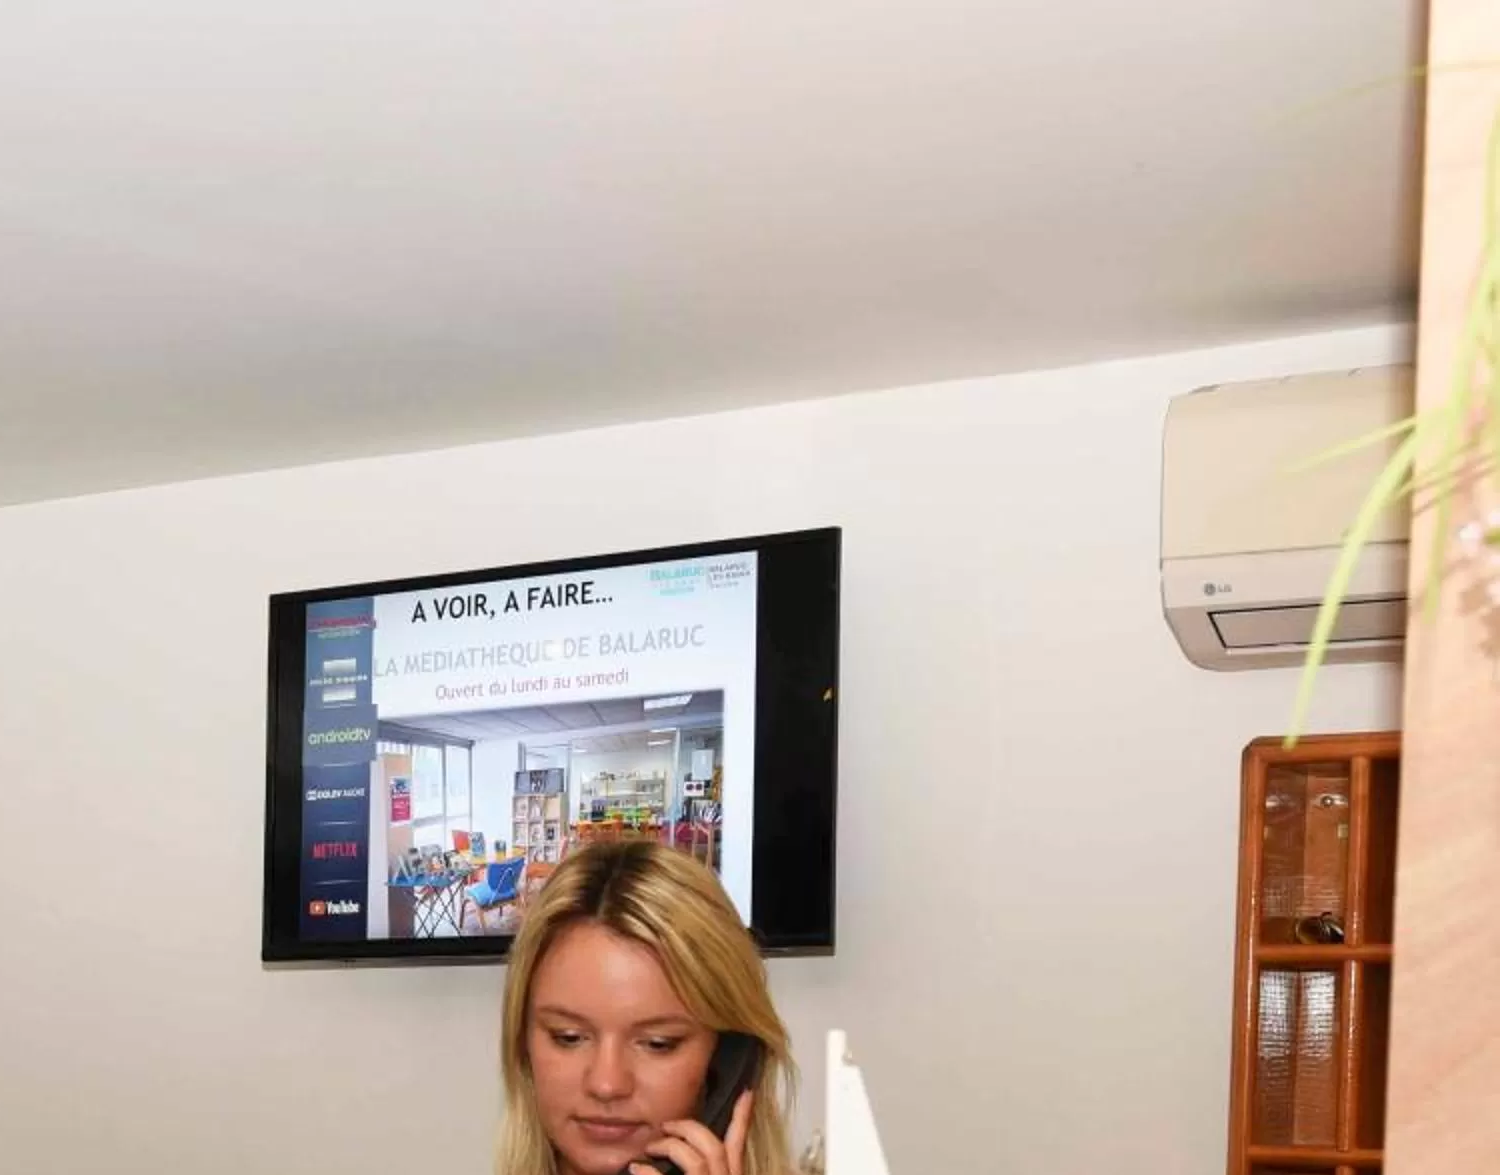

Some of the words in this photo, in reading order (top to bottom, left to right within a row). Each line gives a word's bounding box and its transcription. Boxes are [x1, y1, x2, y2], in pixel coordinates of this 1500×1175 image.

[411, 600, 427, 623] A
[433, 593, 496, 620] VOIR,
[504, 590, 520, 613] A
[527, 580, 614, 611] FAIRE...
[374, 658, 399, 678] LA
[404, 639, 554, 675] MEDIATHEQUE
[563, 635, 591, 660] DE
[600, 624, 706, 656] BALARUC
[435, 683, 484, 700] Ouvert
[489, 679, 507, 697] du
[511, 675, 549, 694] lundi
[553, 675, 571, 689] au
[576, 667, 630, 689] samedi
[313, 842, 357, 858] NETFLIX
[326, 899, 360, 916] YouTube
